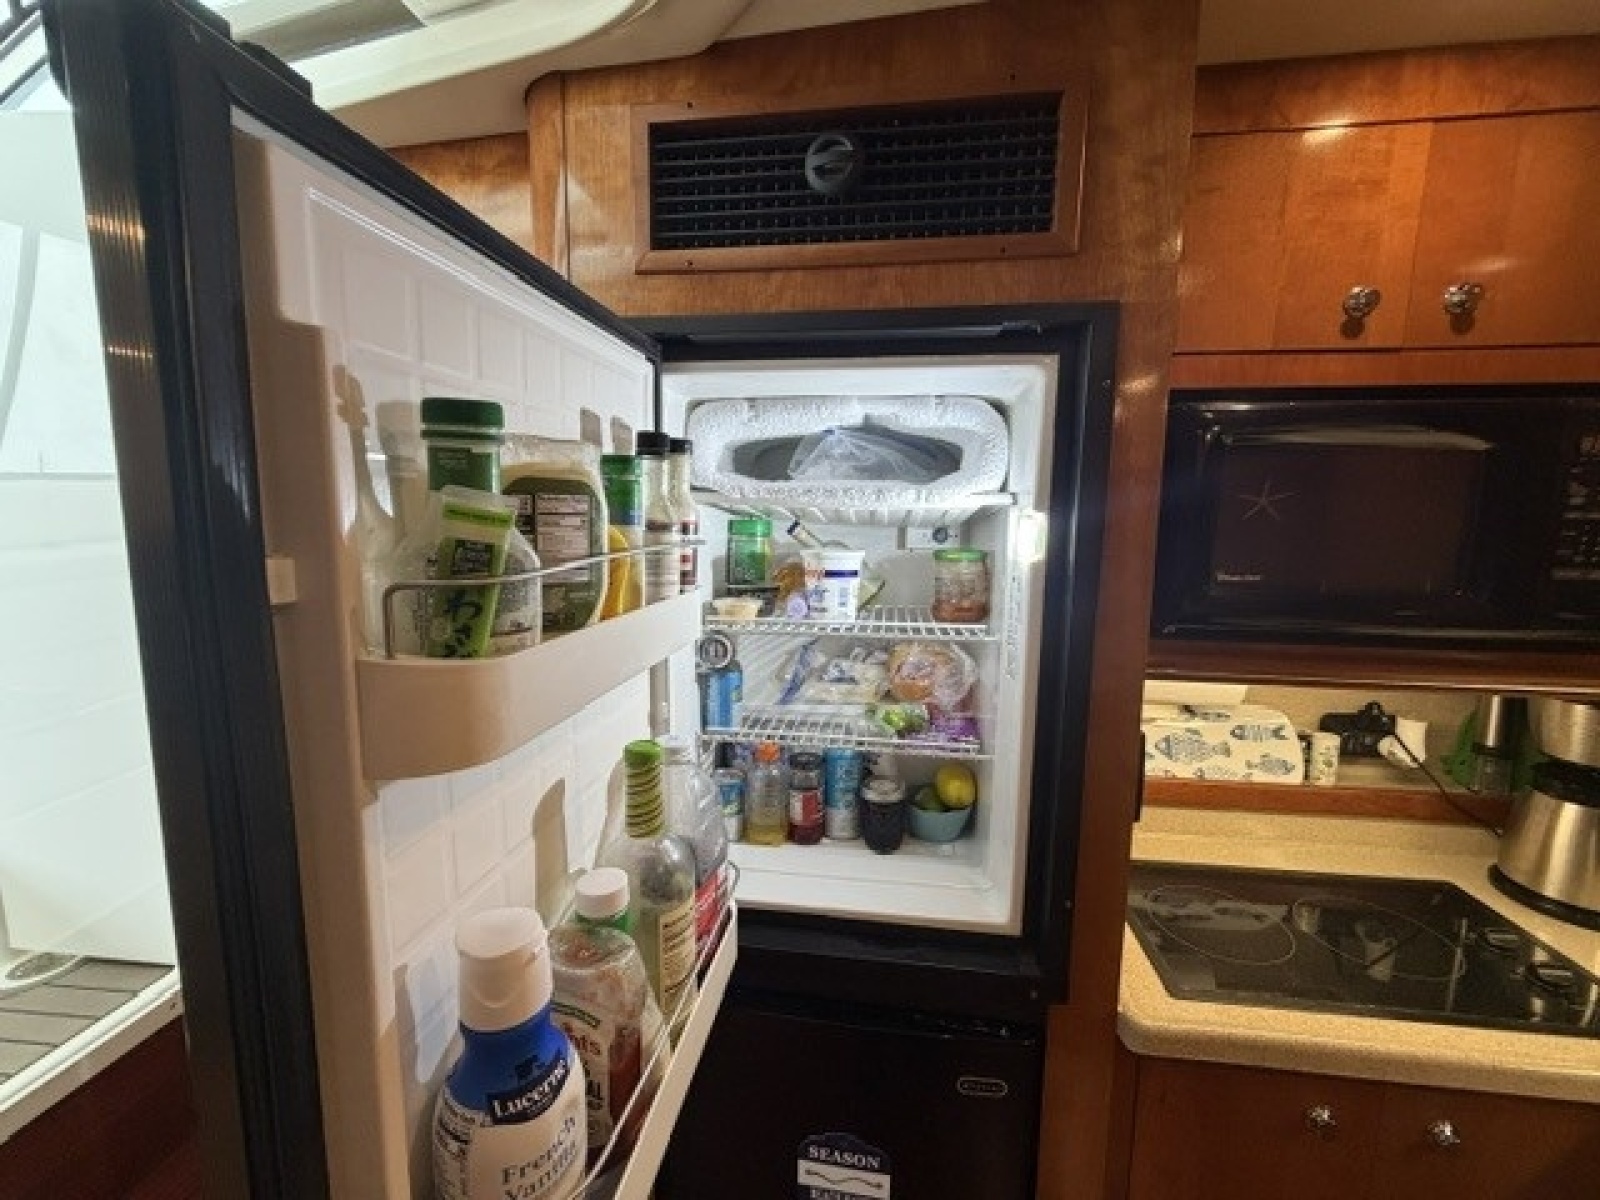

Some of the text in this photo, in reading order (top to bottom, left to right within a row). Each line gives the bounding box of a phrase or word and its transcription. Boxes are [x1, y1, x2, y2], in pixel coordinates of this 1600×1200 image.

[492, 1059, 567, 1119] Lucerne
[502, 1115, 577, 1186] French
[808, 1144, 881, 1169] SEASON
